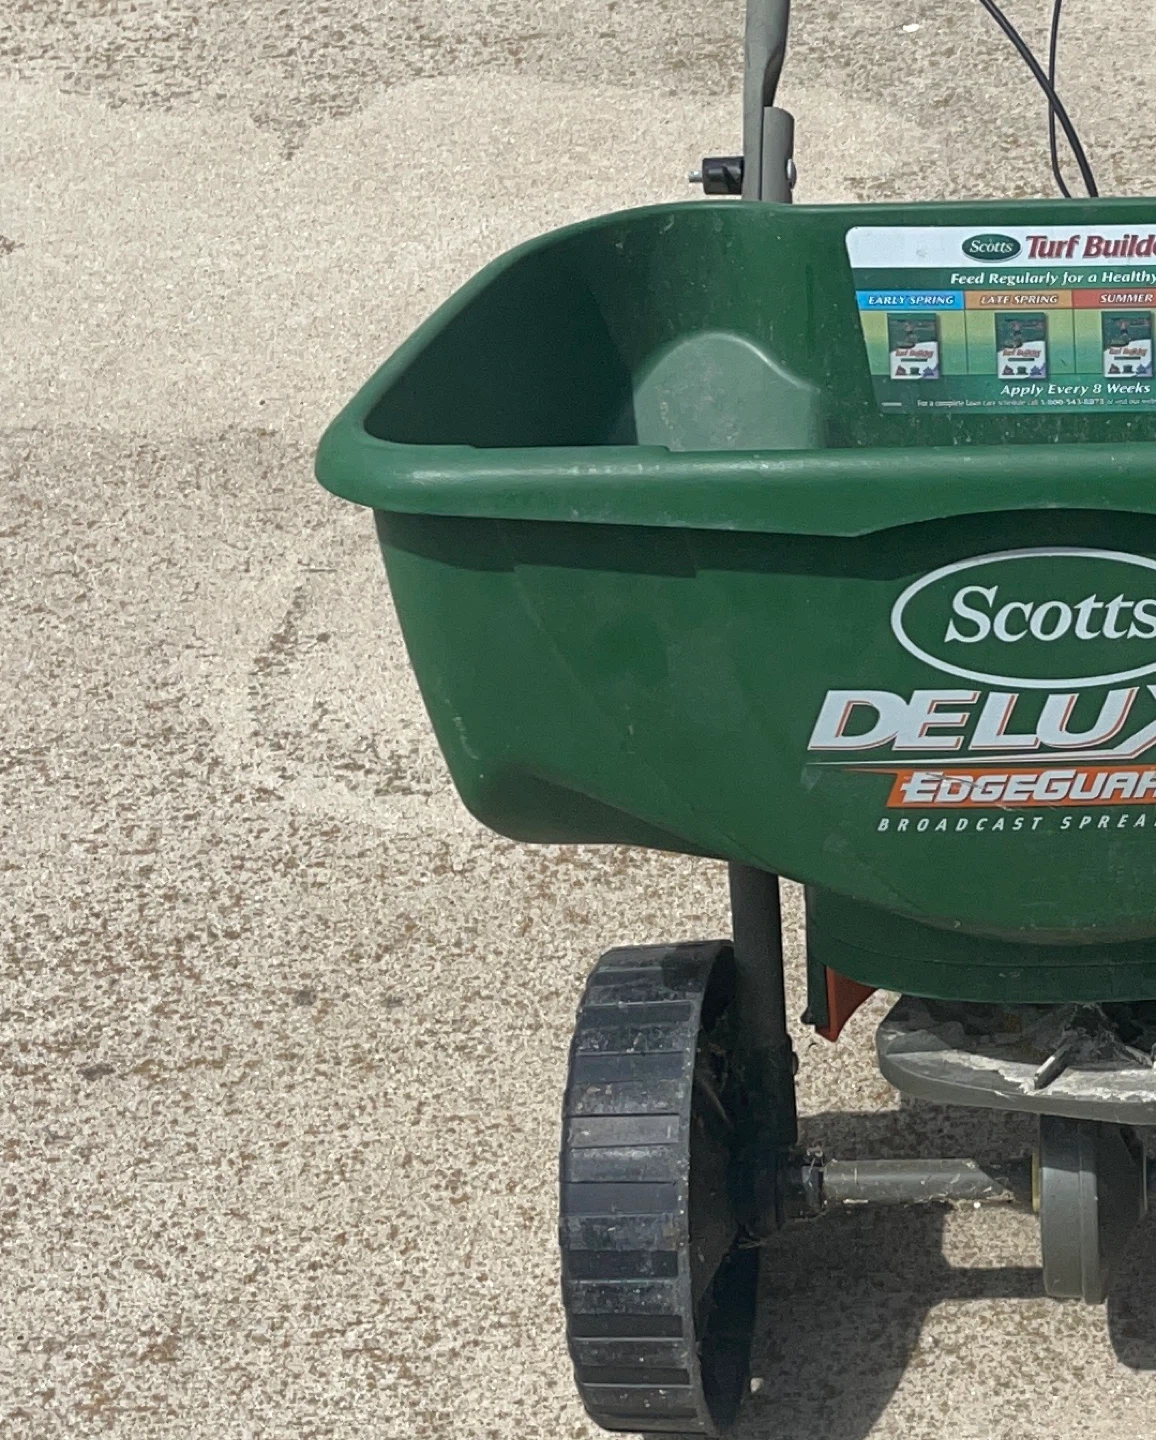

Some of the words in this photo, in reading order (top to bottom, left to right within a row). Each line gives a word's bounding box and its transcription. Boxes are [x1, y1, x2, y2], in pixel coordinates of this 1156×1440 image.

[969, 238, 1014, 255] Scotts
[1025, 234, 1081, 260] Turf
[950, 272, 985, 285] Feed
[989, 271, 1058, 287] Regularly
[1060, 271, 1084, 286] for
[1087, 274, 1098, 283] a
[868, 295, 905, 306] EARLY
[909, 295, 955, 305] SPRING
[979, 295, 1011, 306] LATE
[1014, 295, 1059, 305] SPRING
[1099, 293, 1154, 303] SUMMER
[1000, 383, 1044, 398] Apply
[1047, 383, 1090, 397] Every
[1092, 383, 1103, 394] 8
[1107, 382, 1151, 394] Weeks
[877, 816, 1044, 833] BROADCAST
